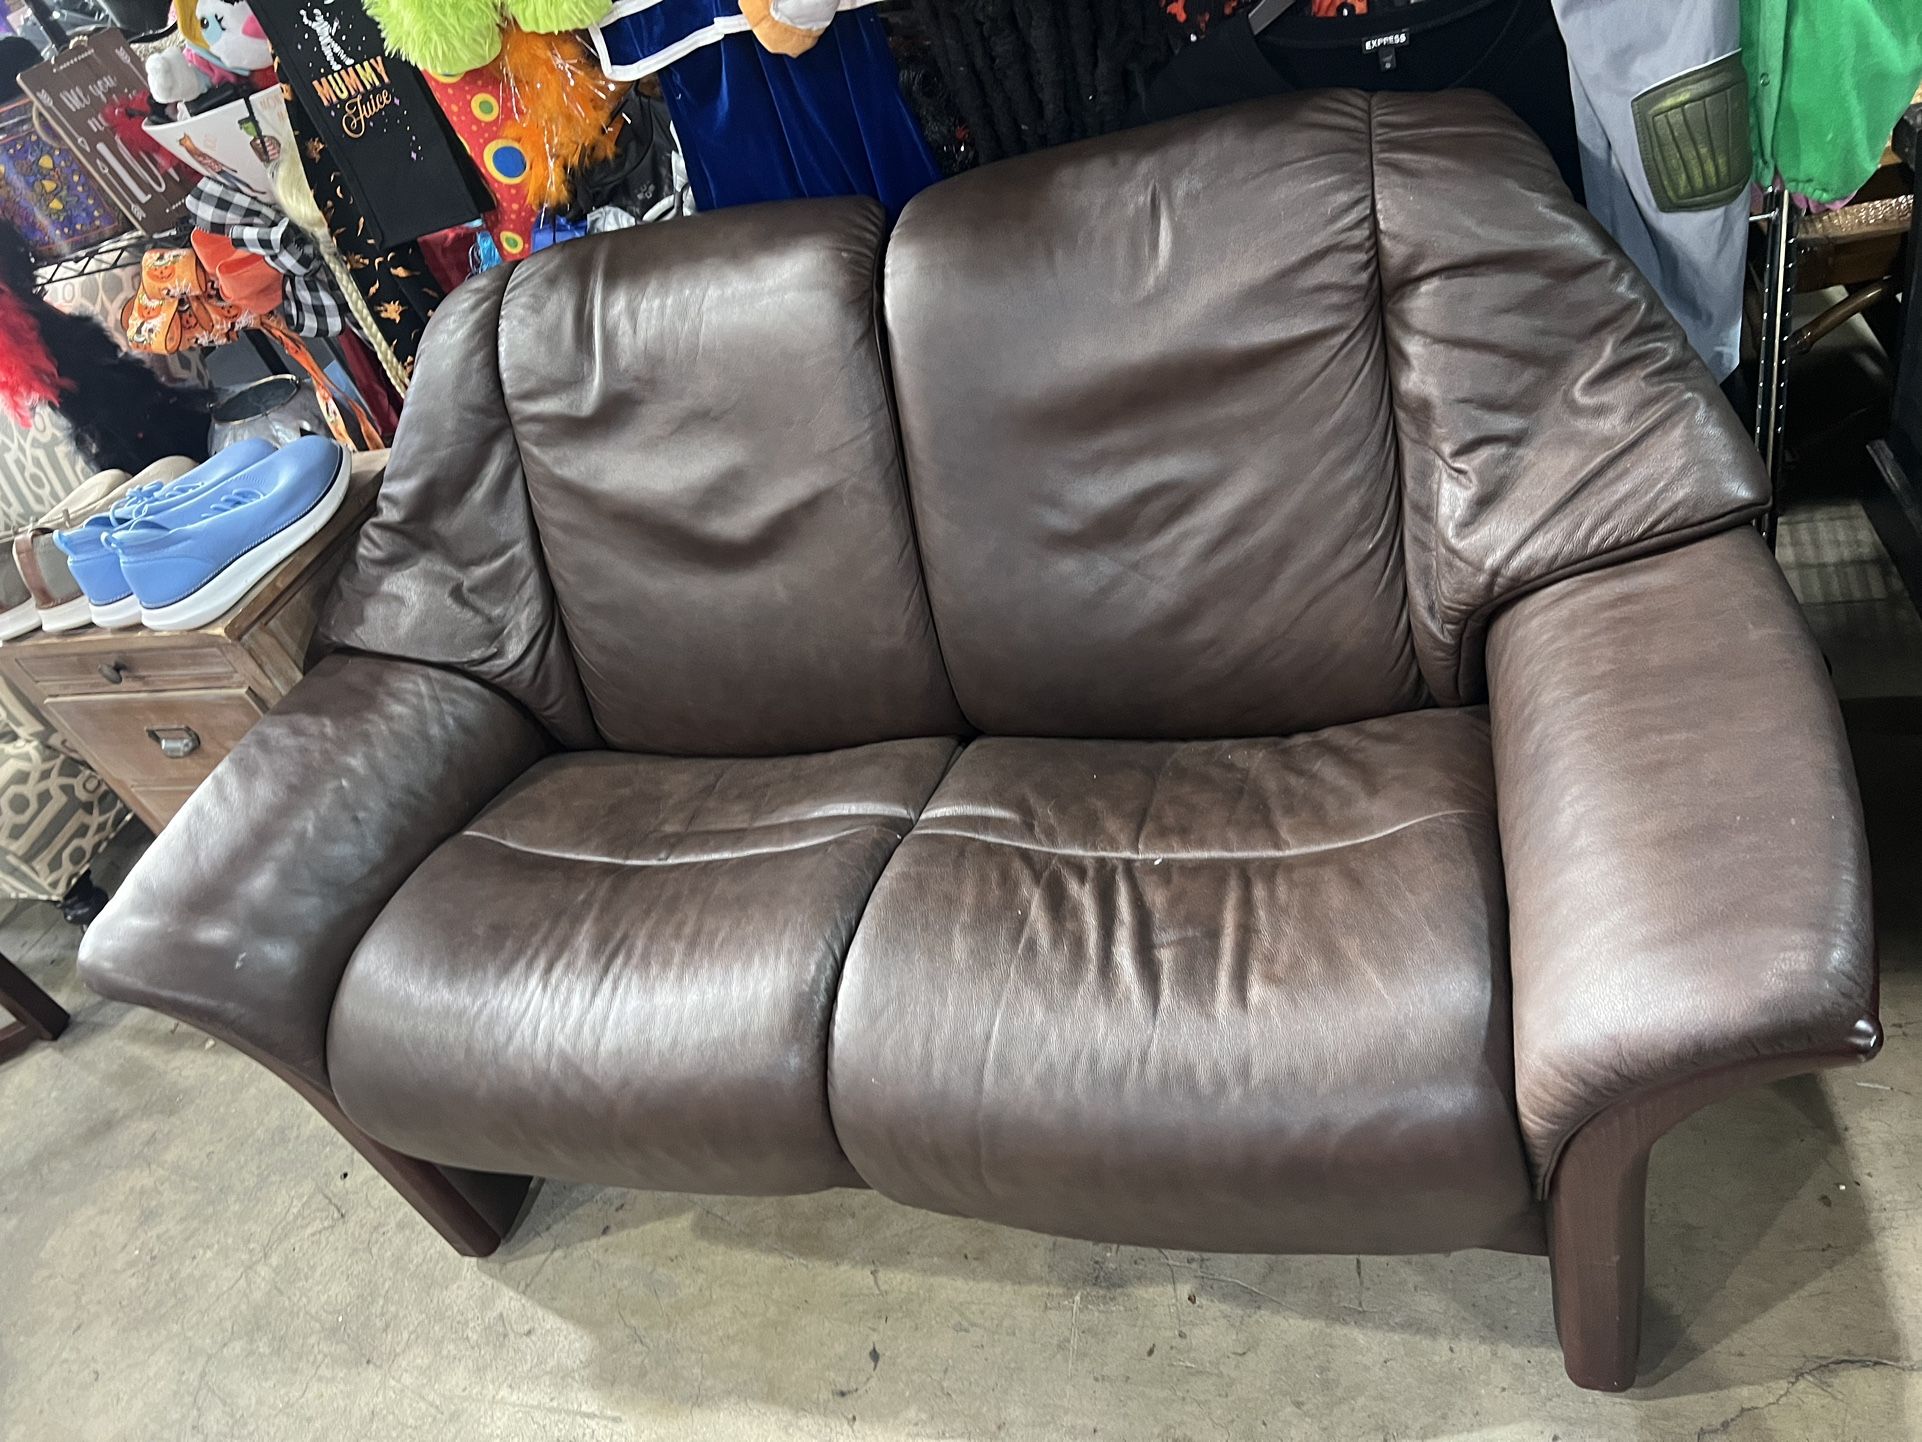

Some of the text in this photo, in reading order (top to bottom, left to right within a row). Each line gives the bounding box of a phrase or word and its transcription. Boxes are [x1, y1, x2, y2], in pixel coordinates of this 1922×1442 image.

[1365, 33, 1406, 50] EXPRESS
[89, 74, 117, 104] you
[312, 55, 391, 107] MUMMY
[342, 89, 392, 138] Juice
